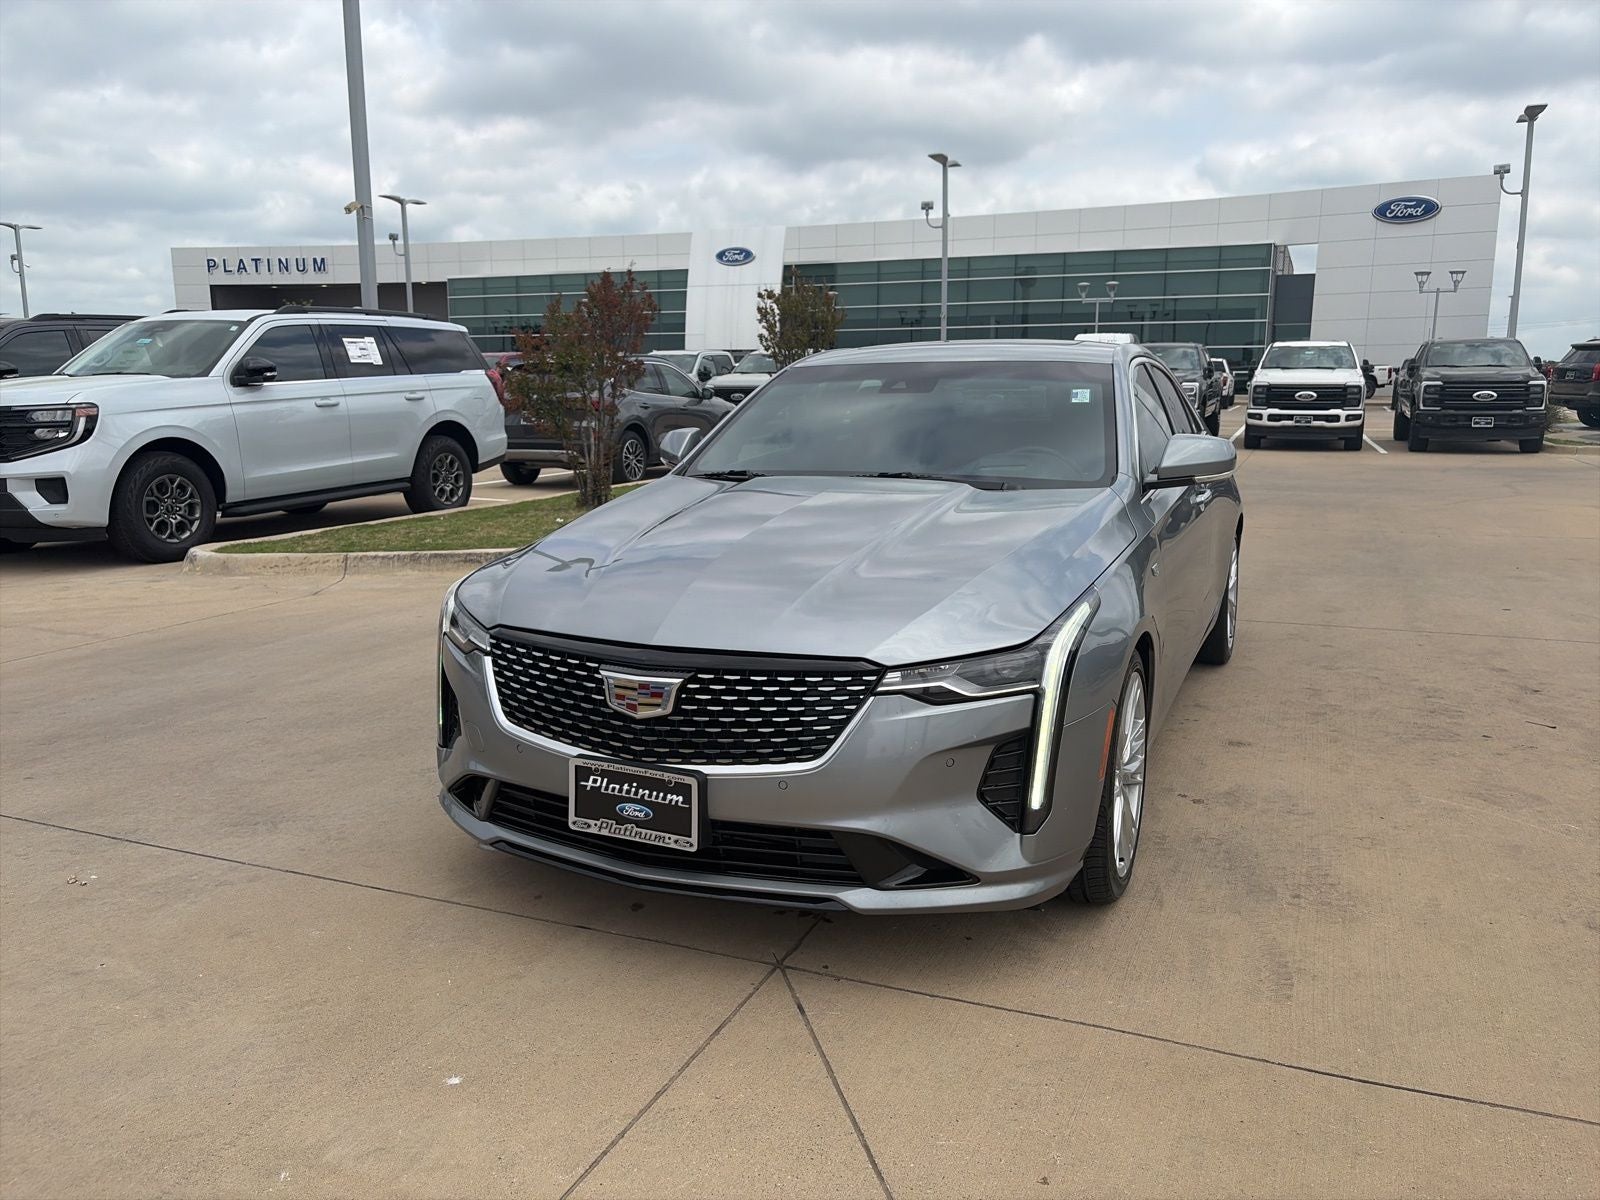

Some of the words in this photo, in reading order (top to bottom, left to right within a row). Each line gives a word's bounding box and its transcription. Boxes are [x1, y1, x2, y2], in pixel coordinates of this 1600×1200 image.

[1386, 201, 1426, 217] Ford
[722, 250, 746, 261] Ford
[206, 257, 327, 274] PLATINUM
[582, 760, 686, 782] www.PlatinumFord.com
[580, 775, 690, 808] Platinum
[623, 805, 647, 818] Ford
[598, 820, 671, 845] Platinum
